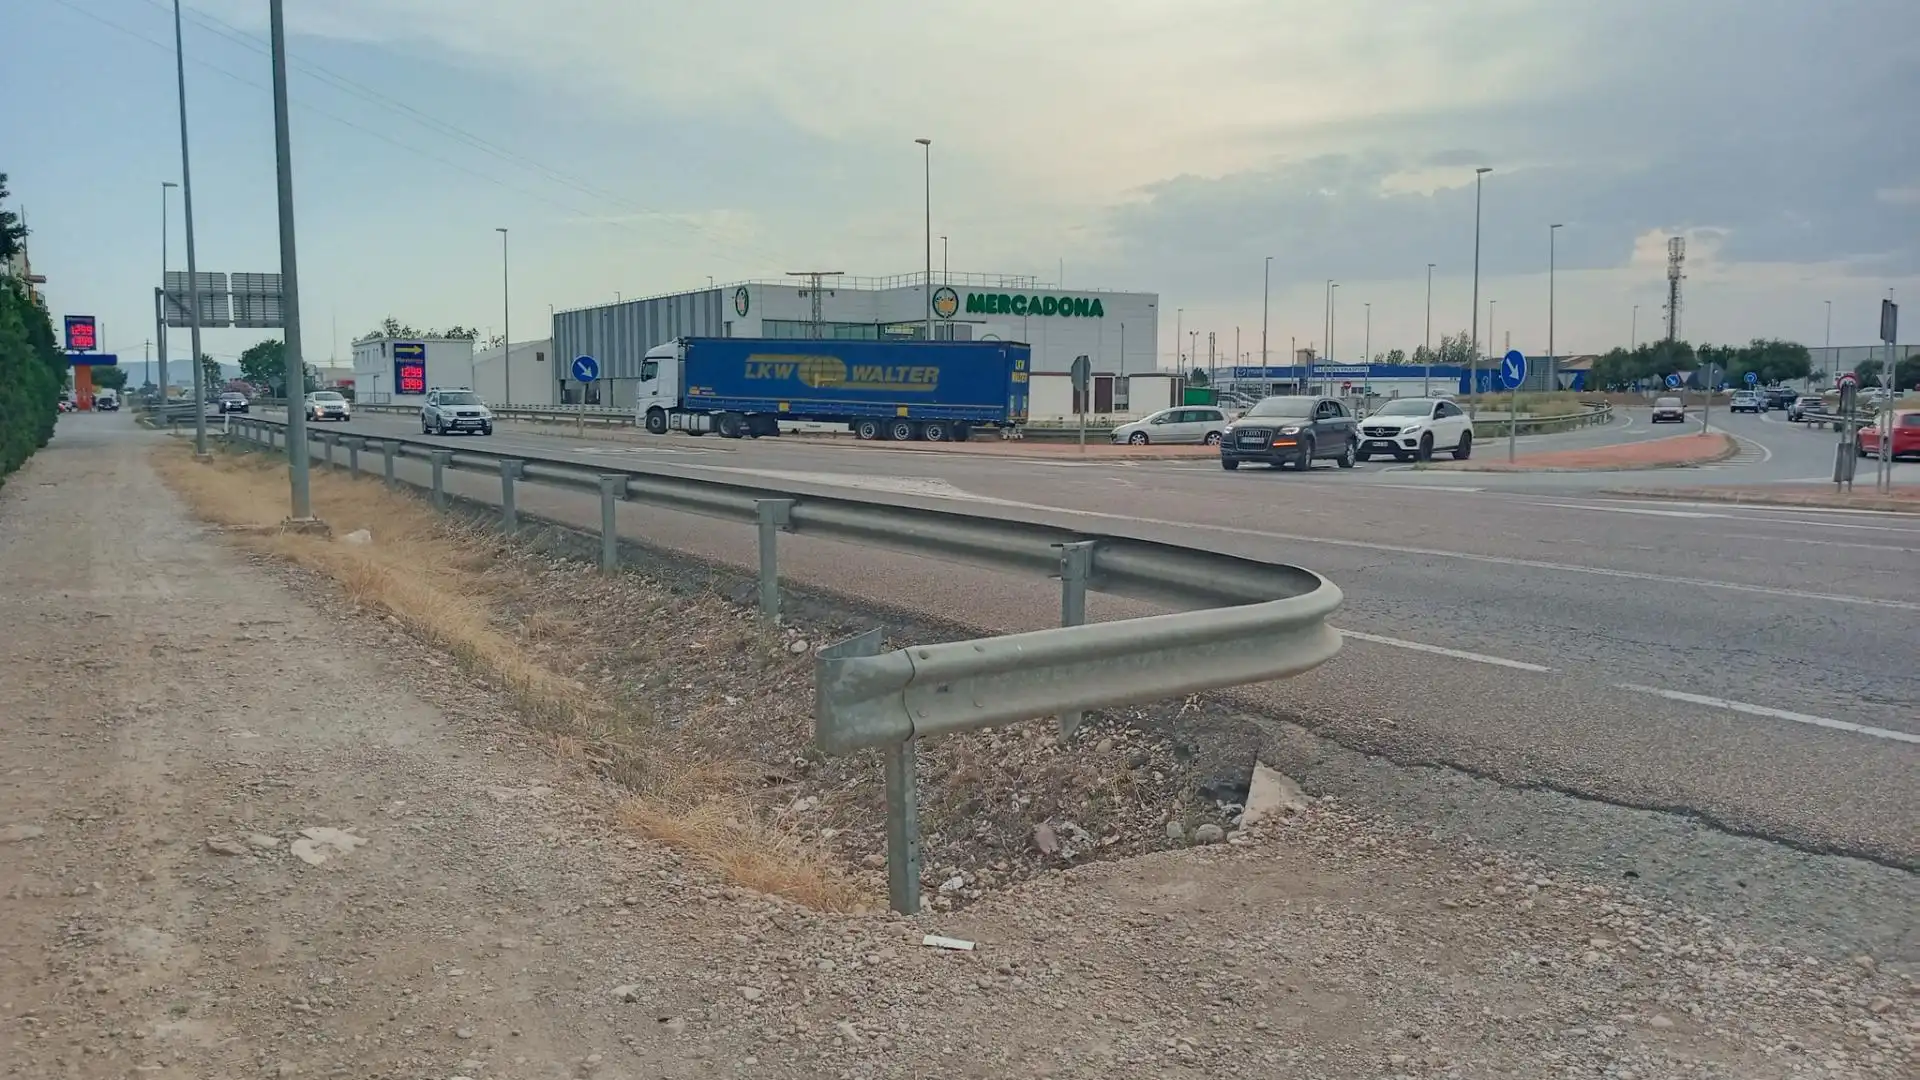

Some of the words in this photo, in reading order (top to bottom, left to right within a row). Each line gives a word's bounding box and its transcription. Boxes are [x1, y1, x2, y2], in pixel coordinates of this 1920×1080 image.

[966, 293, 1104, 317] MERCADONA
[744, 363, 796, 379] LKW
[851, 364, 940, 383] WALTER
